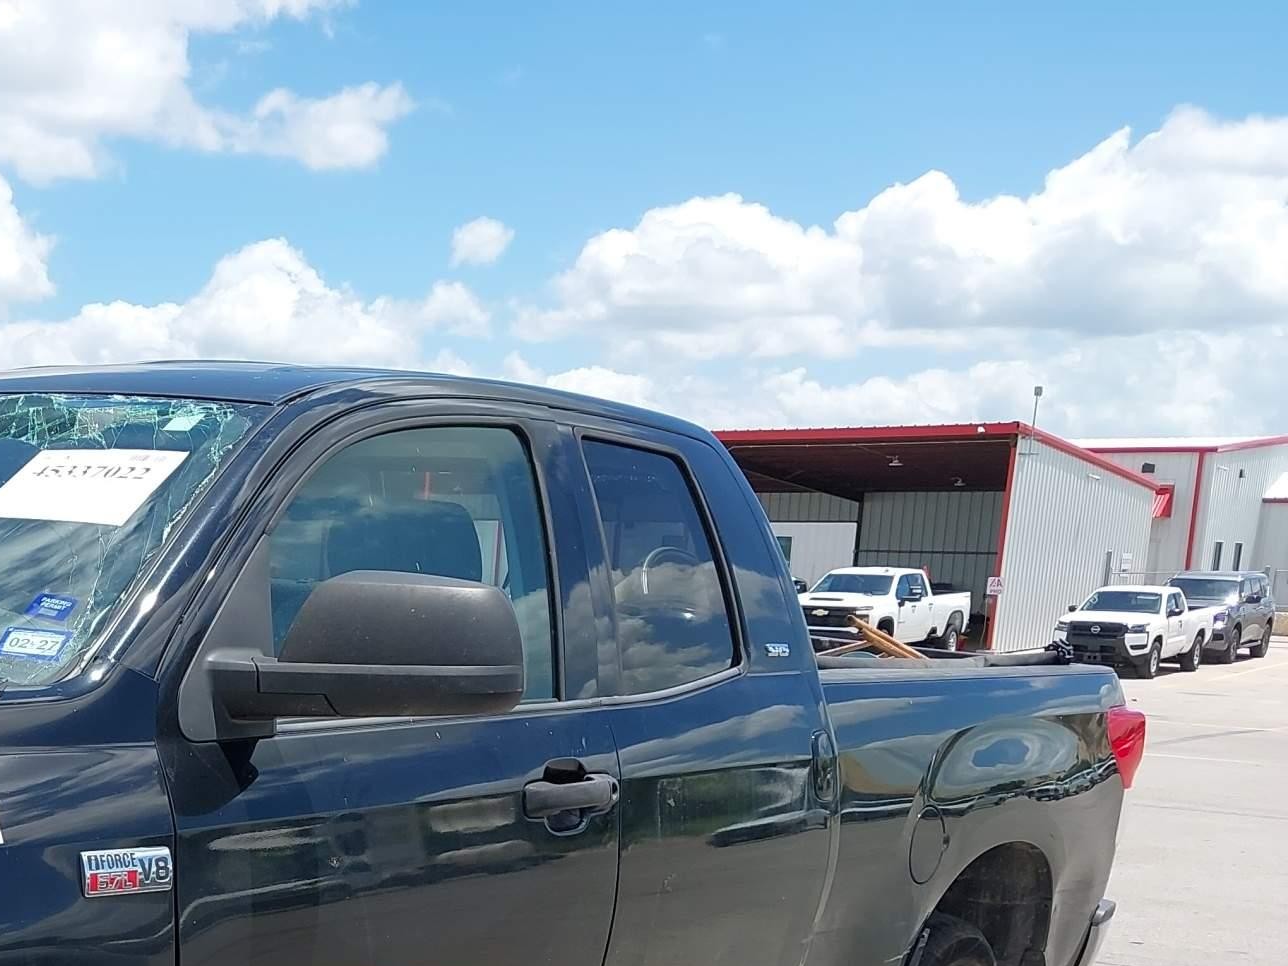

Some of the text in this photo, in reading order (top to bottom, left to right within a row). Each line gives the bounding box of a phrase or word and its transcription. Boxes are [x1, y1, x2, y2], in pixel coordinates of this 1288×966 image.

[33, 465, 152, 480] 45337022
[41, 596, 73, 607] PARKING
[137, 855, 171, 884] V8
